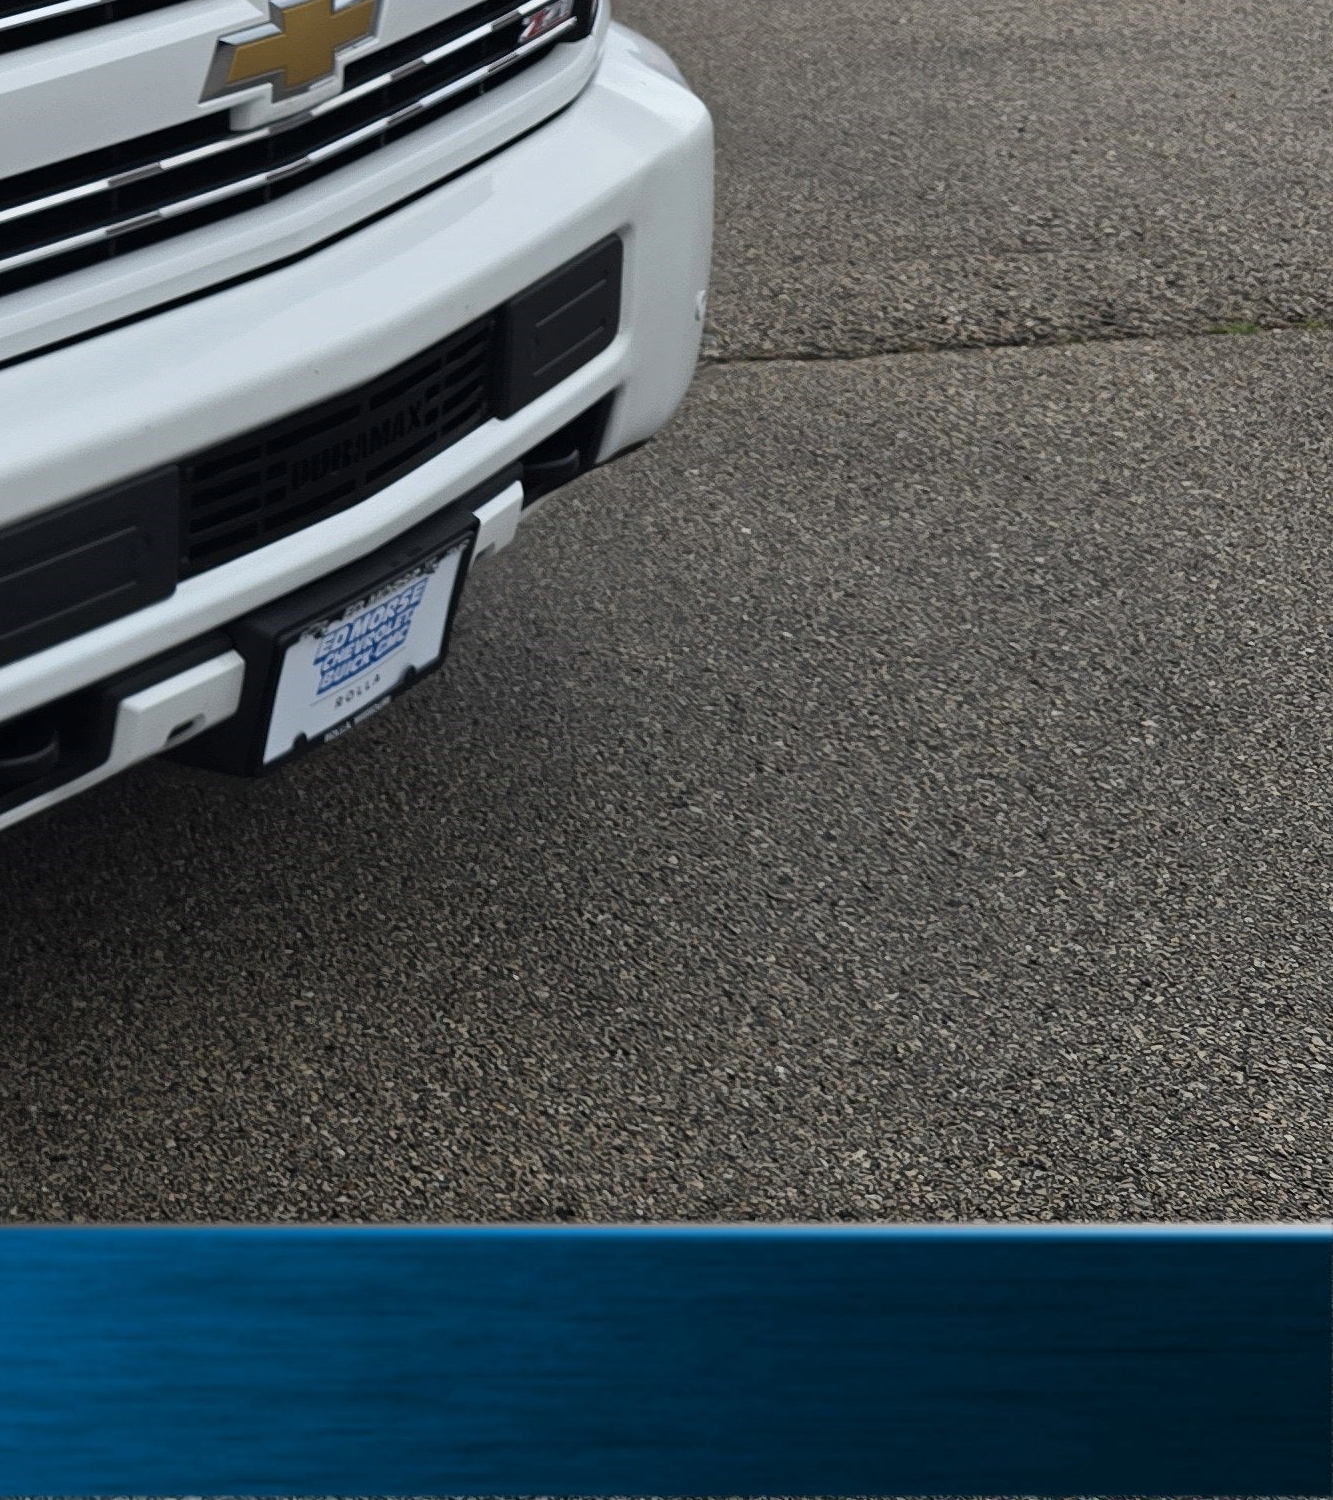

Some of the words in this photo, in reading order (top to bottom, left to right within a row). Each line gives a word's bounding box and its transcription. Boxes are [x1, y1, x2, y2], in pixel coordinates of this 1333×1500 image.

[321, 624, 350, 651] ED
[351, 583, 425, 640] MORSE
[335, 673, 381, 708] ROLLA
